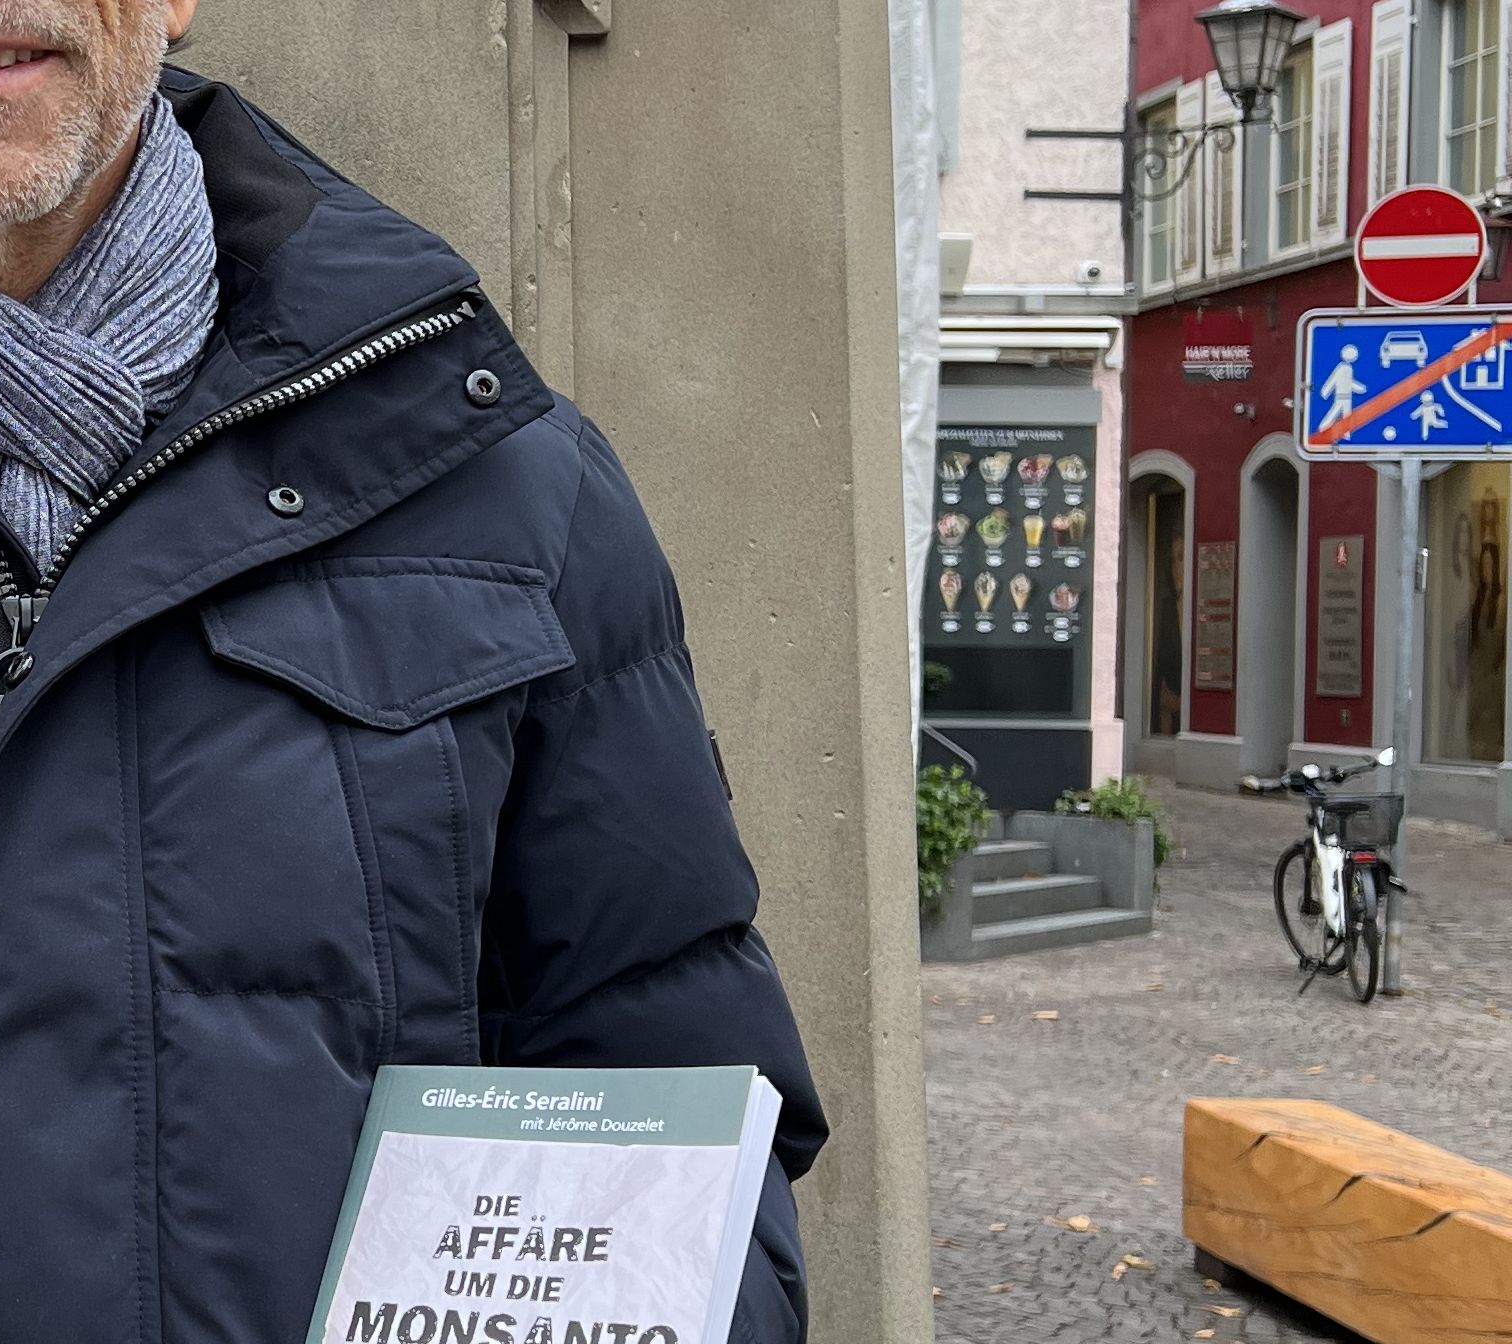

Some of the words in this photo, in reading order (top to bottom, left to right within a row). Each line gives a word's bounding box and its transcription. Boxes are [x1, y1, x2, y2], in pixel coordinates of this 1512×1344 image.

[421, 1086, 520, 1110] Gilles-Éric
[523, 1090, 605, 1112] Seralini
[520, 1117, 544, 1131] mit
[545, 1117, 597, 1132] Jérôme
[600, 1117, 665, 1133] Douzelet
[473, 1195, 522, 1217] DIE
[432, 1214, 614, 1262] AFFÄRE
[444, 1269, 497, 1298] UM
[506, 1273, 565, 1302] DIE
